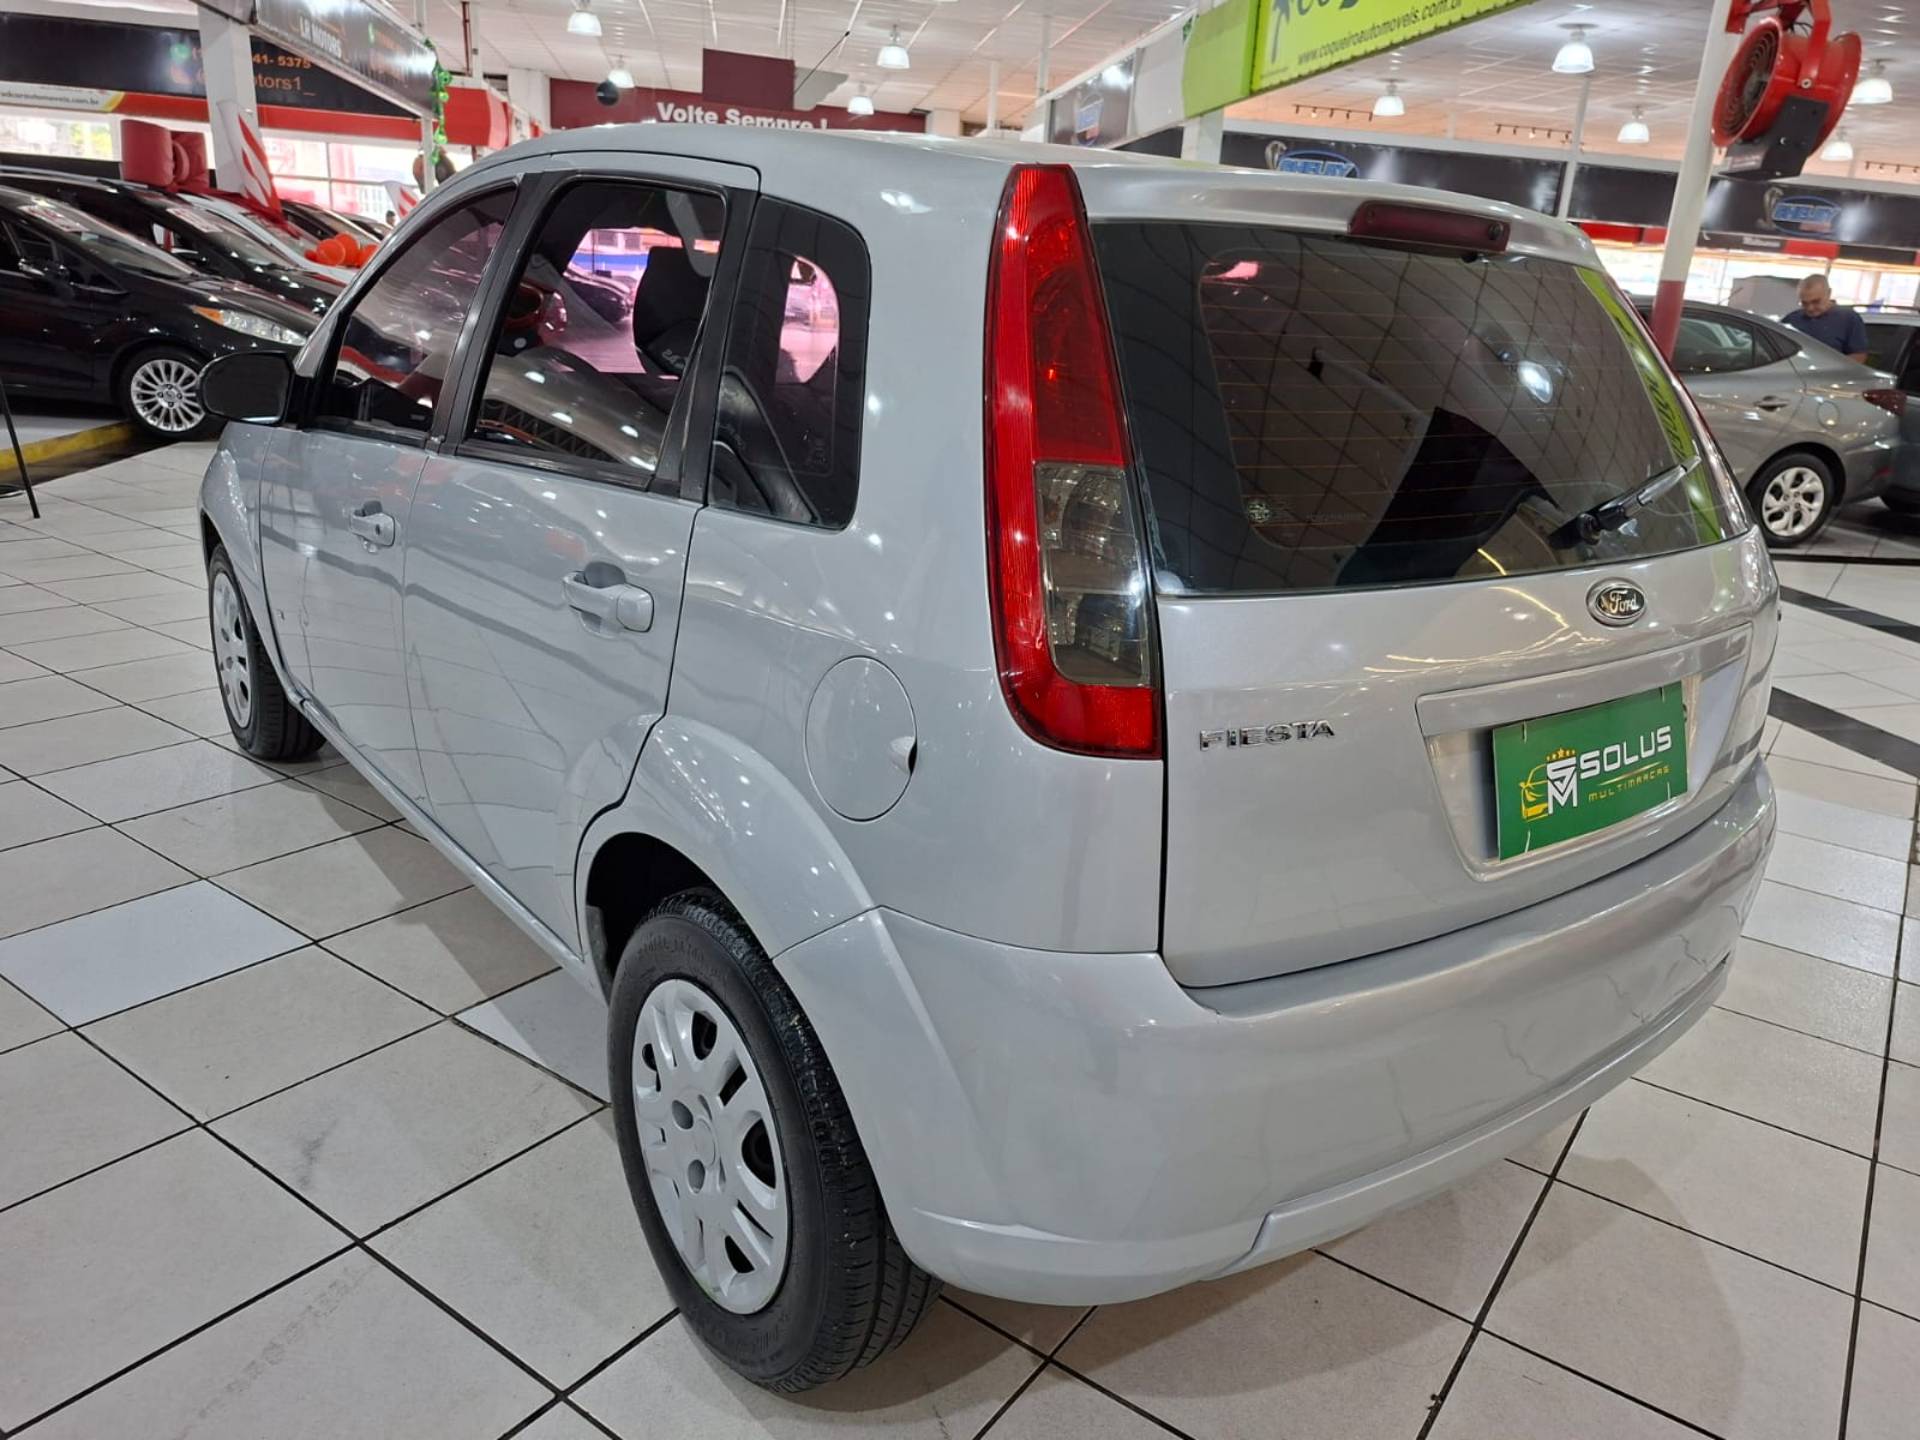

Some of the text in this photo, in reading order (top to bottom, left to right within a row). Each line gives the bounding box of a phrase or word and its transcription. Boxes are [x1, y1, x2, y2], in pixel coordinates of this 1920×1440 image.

[656, 102, 719, 124] Volte
[1610, 589, 1640, 614] Ford
[1200, 719, 1336, 751] FIESTA
[1580, 725, 1672, 780] SOLUS
[1588, 765, 1670, 801] MULTIMARCAS
